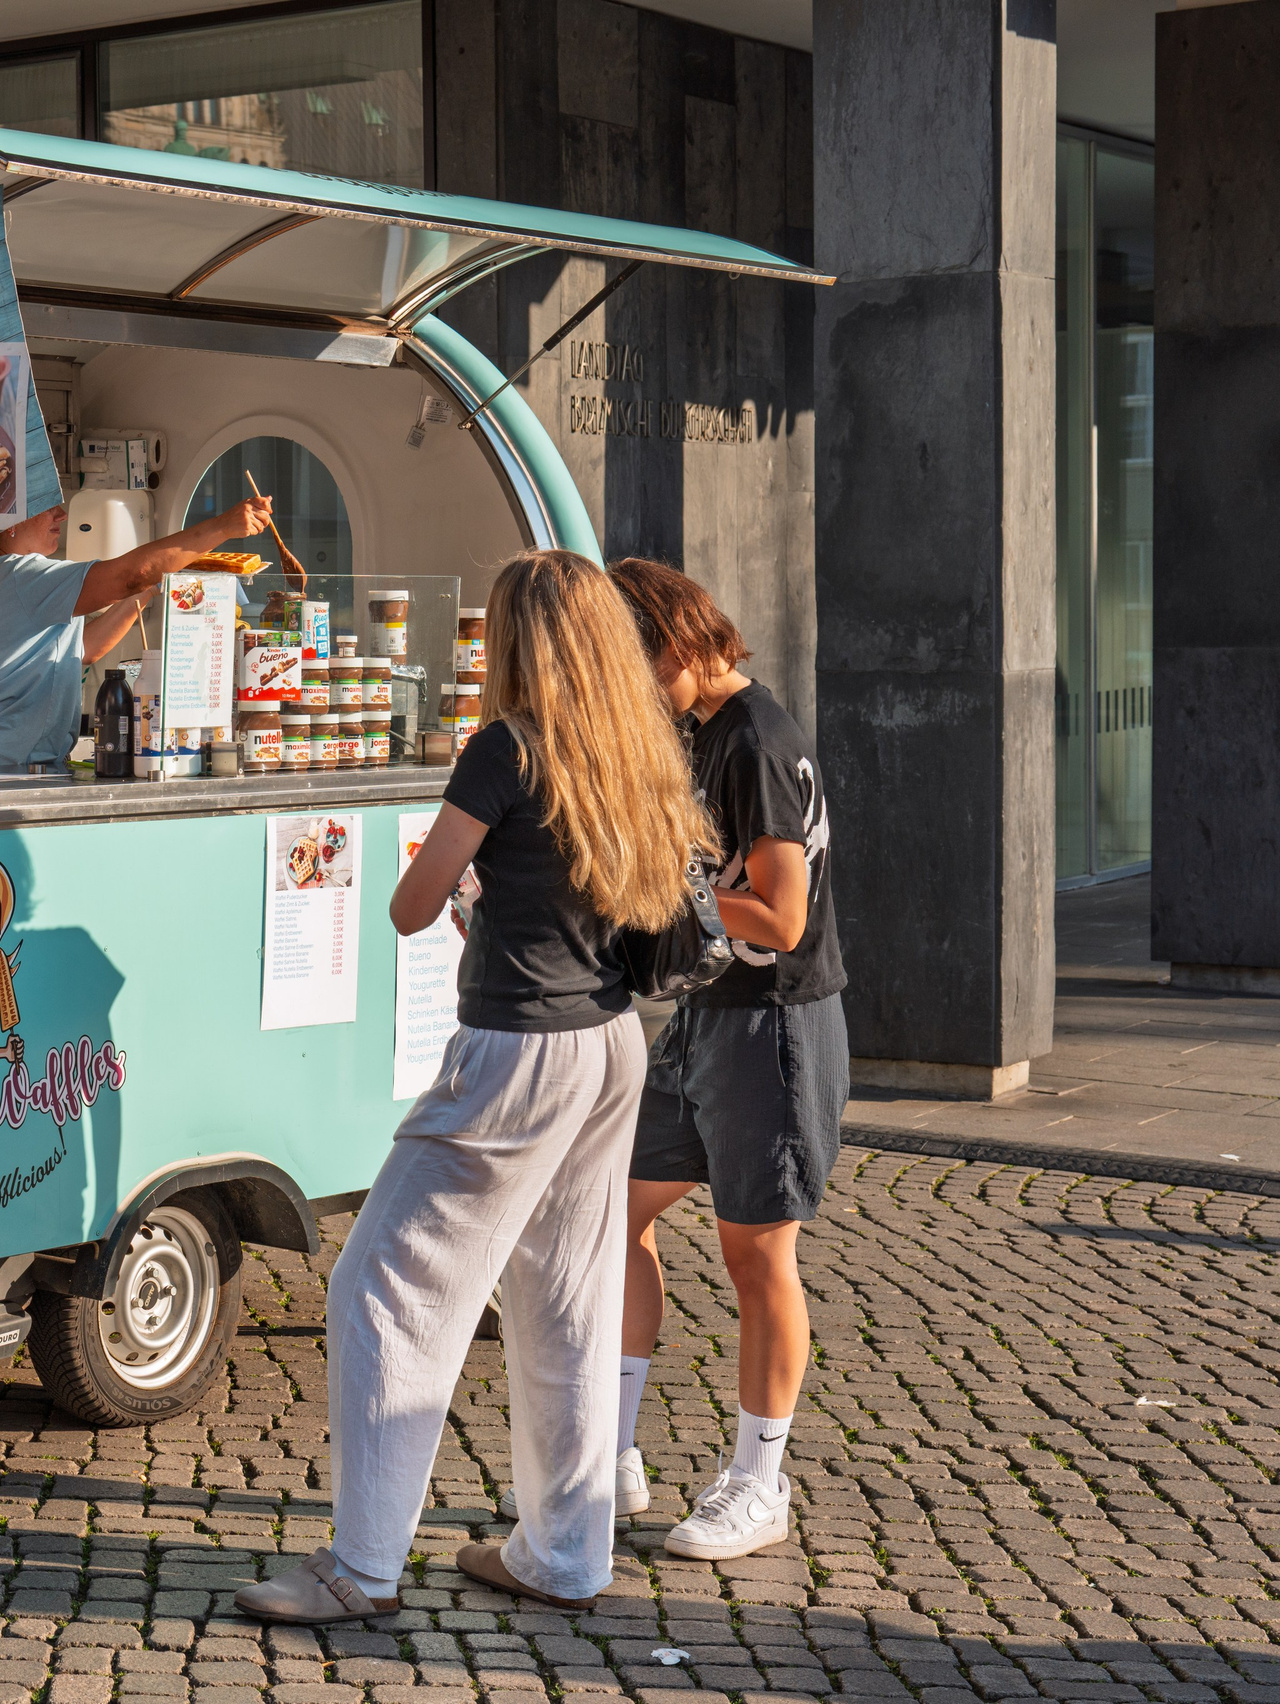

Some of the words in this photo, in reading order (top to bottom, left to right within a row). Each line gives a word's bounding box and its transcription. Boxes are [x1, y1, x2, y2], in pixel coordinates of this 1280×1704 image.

[260, 652, 288, 664] bueno
[409, 935, 447, 946] Marmelade
[409, 952, 431, 961] Bueno
[409, 963, 449, 976] Kinderriegel
[409, 979, 445, 991] Yougurette
[408, 995, 432, 1005] Nutella
[408, 1008, 438, 1020] Schinken
[408, 1023, 431, 1034] Nutella
[433, 1020, 458, 1031] Banane
[408, 1037, 430, 1049] Nutella
[407, 1051, 442, 1064] Yougurette
